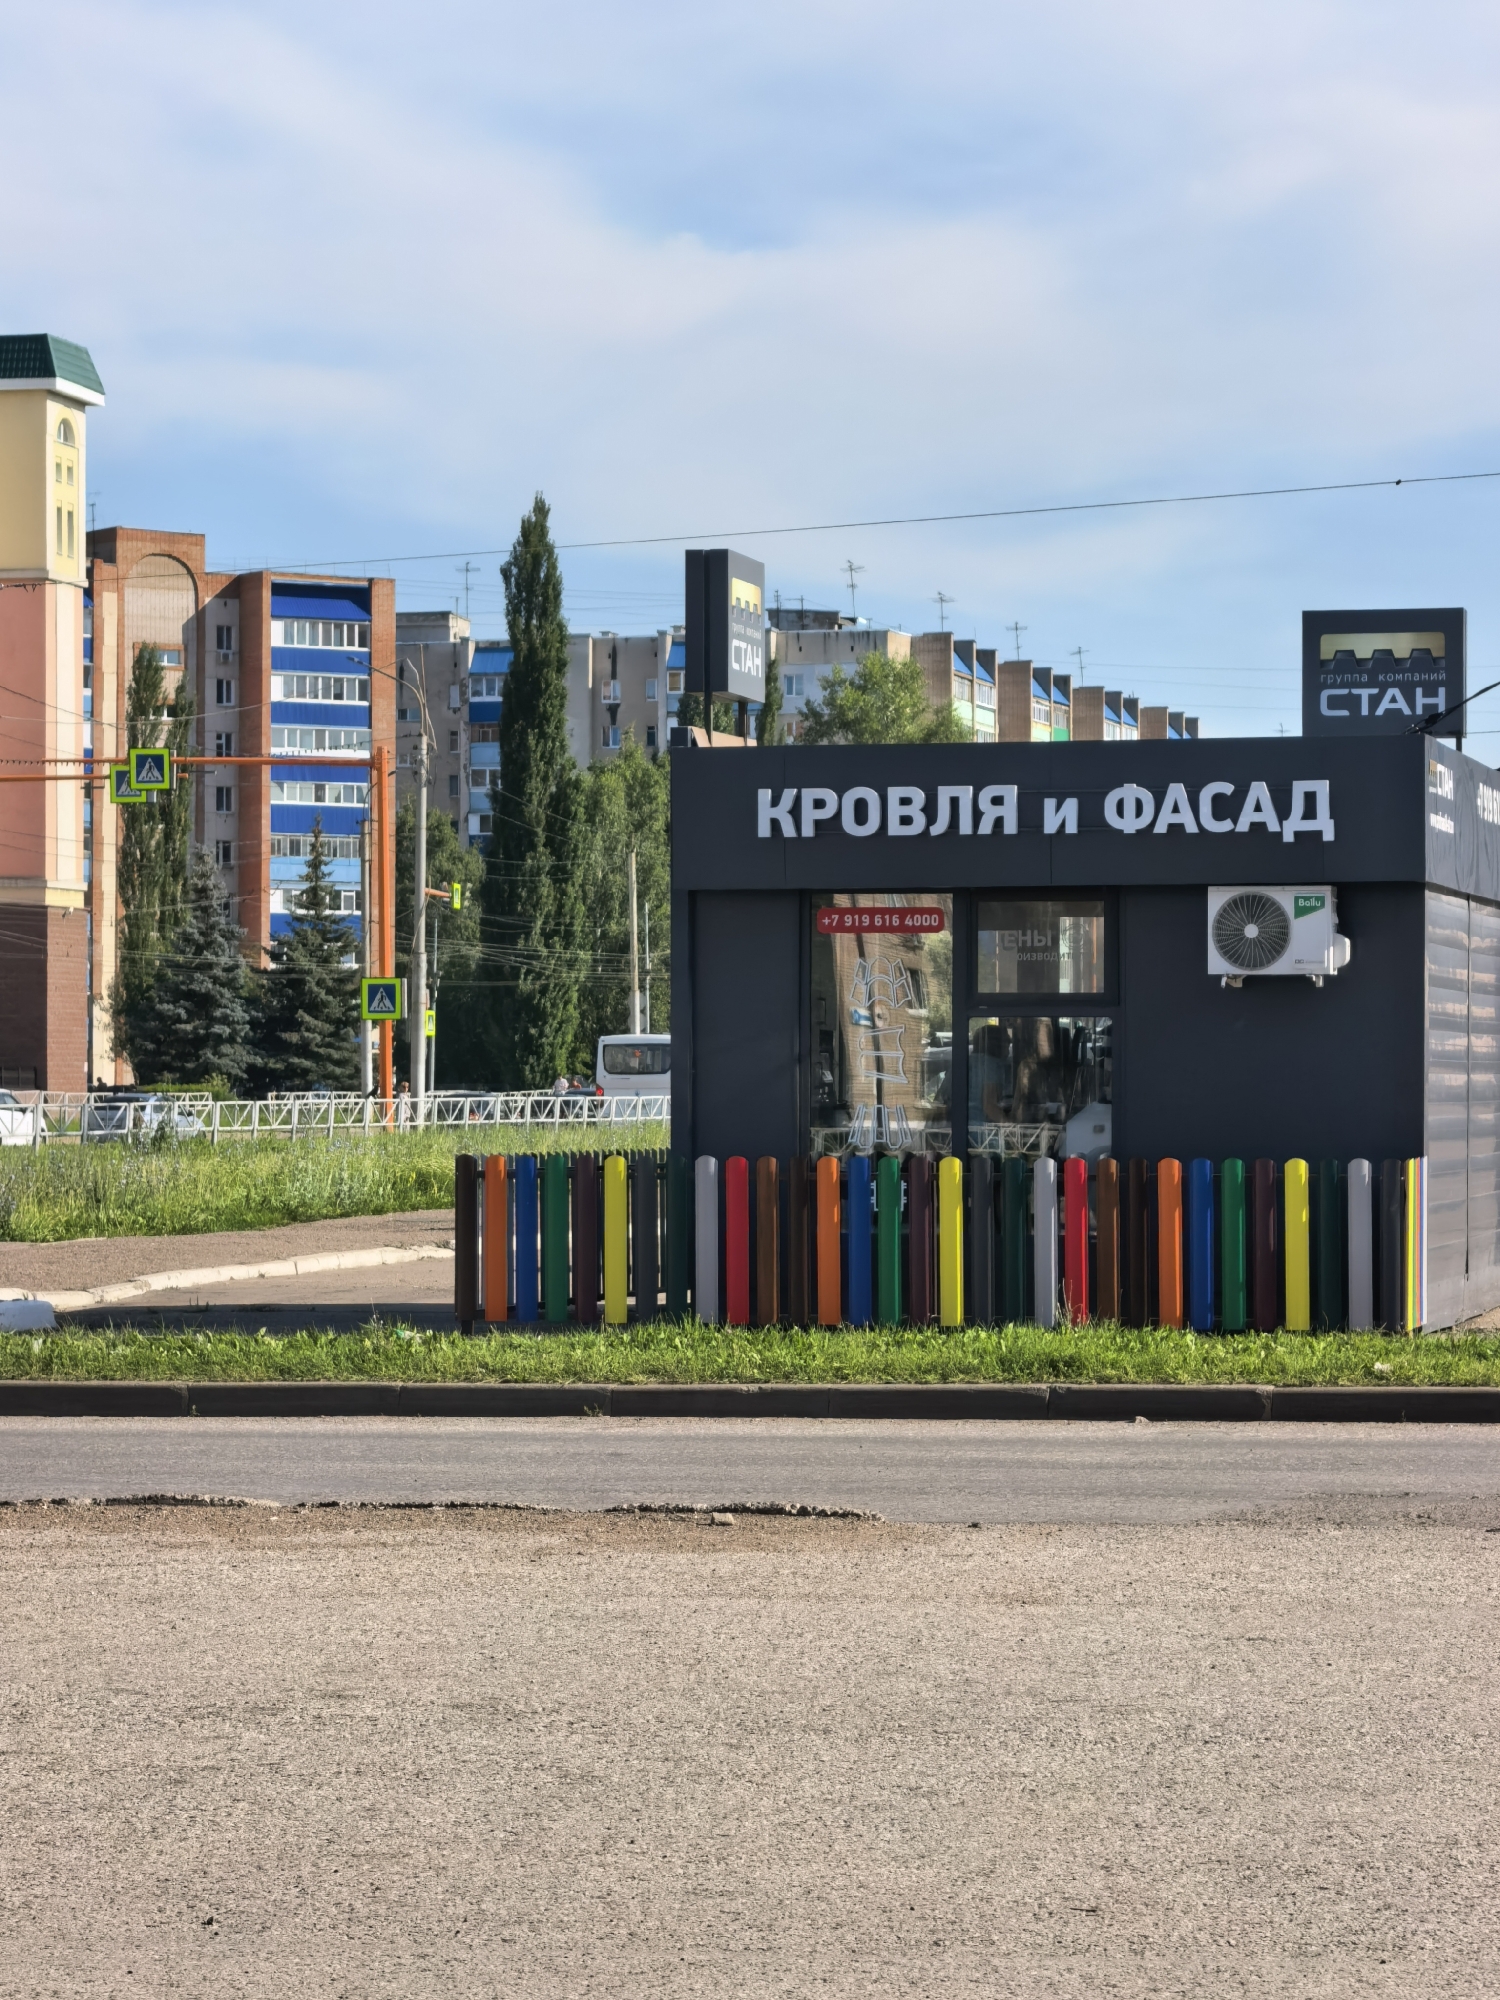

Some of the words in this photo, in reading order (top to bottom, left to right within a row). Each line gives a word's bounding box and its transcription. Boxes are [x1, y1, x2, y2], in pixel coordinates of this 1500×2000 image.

[732, 638, 761, 678] СТАН
[1320, 673, 1368, 685] группа
[1378, 670, 1446, 682] компаний
[1320, 687, 1446, 716] СТАН
[757, 784, 1018, 838] КРОВЛЯ
[1043, 797, 1079, 834] и
[1104, 780, 1335, 842] ФАСАД
[1298, 897, 1321, 907] Ballu
[822, 914, 839, 926] +7
[844, 914, 870, 926] 919
[874, 914, 900, 926] 616
[904, 914, 939, 926] 4000
